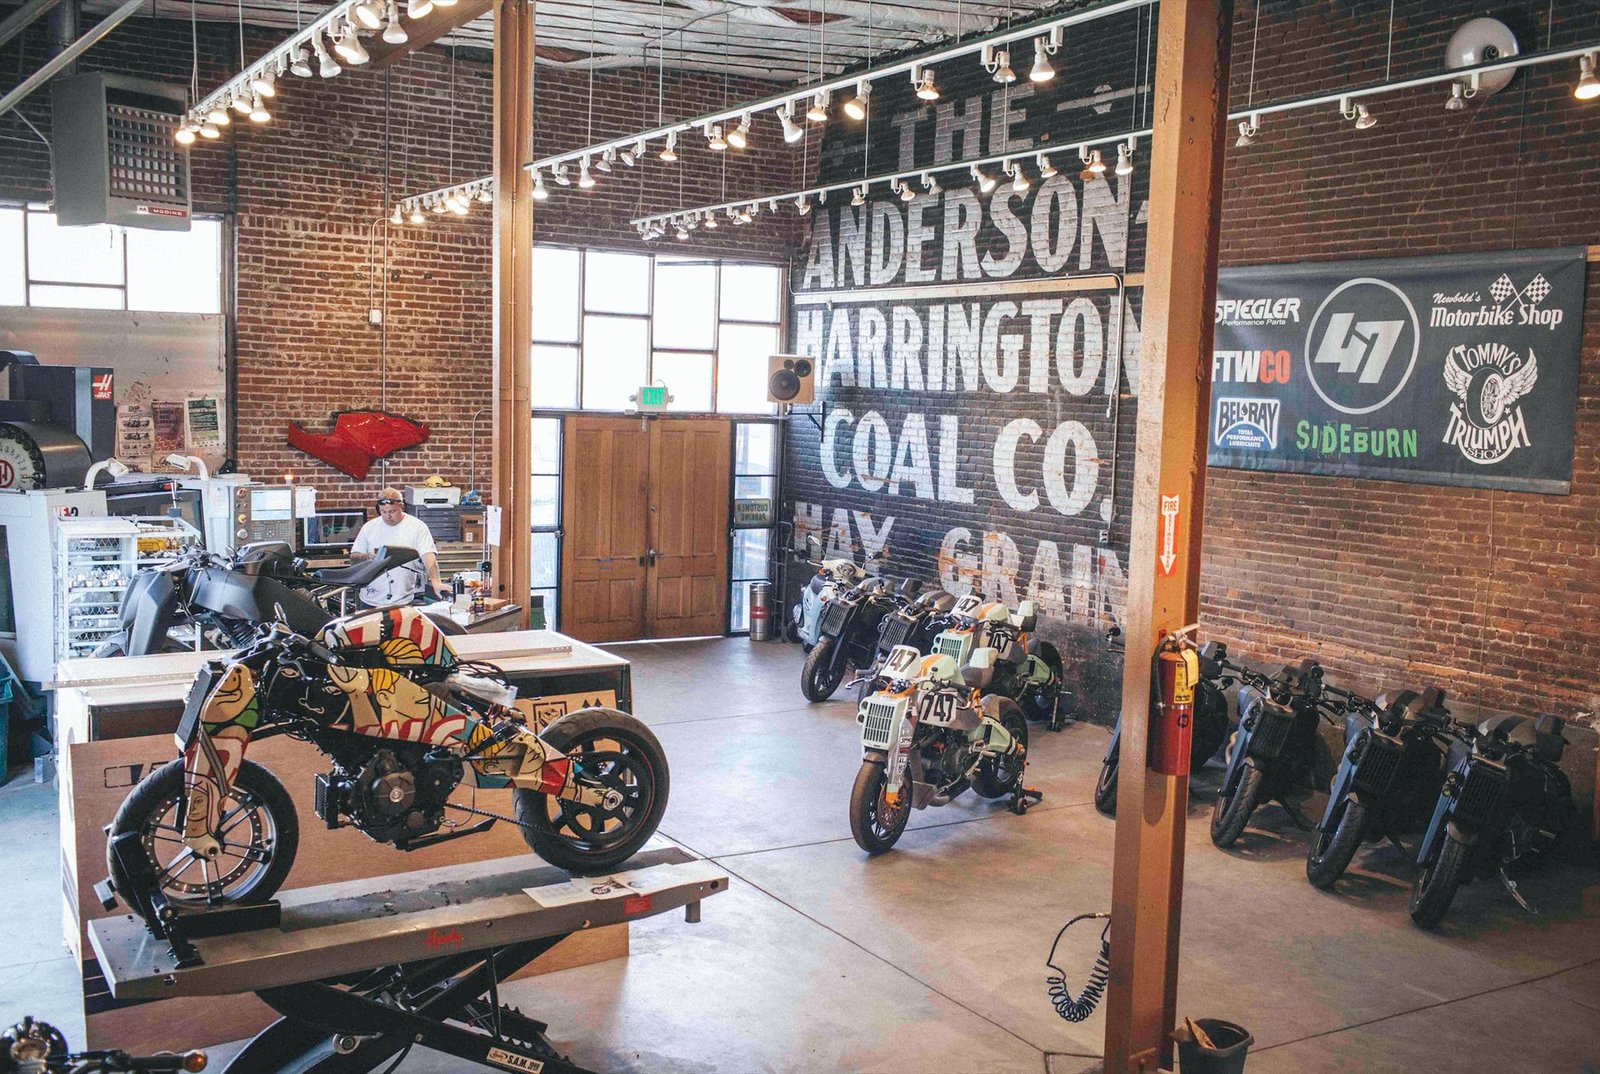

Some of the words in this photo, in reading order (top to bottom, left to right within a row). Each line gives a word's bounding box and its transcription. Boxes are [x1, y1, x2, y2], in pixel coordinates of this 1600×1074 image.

[891, 83, 1036, 171] THE
[803, 172, 1131, 289] ANDERSON
[1215, 298, 1301, 324] SPIEGLER
[1433, 292, 1481, 304] Newbold's
[1430, 305, 1514, 327] Motorbike
[1518, 304, 1564, 331] Shop
[796, 294, 1143, 397] HARRINGTON
[1314, 313, 1405, 383] 47
[1455, 343, 1523, 375] TOMMY'S
[1212, 350, 1291, 384] FTWCO
[643, 388, 665, 405] EXIT
[1226, 434, 1264, 442] PERFORMANCE
[1296, 419, 1417, 458] SIDEBURN
[1442, 402, 1531, 449] TRIUMPH
[820, 408, 975, 504] COAL
[993, 418, 1114, 520] CO.
[1467, 447, 1502, 459] SHOP
[1164, 501, 1177, 511] FIRE
[794, 501, 896, 575] HAY
[922, 694, 955, 722] 747
